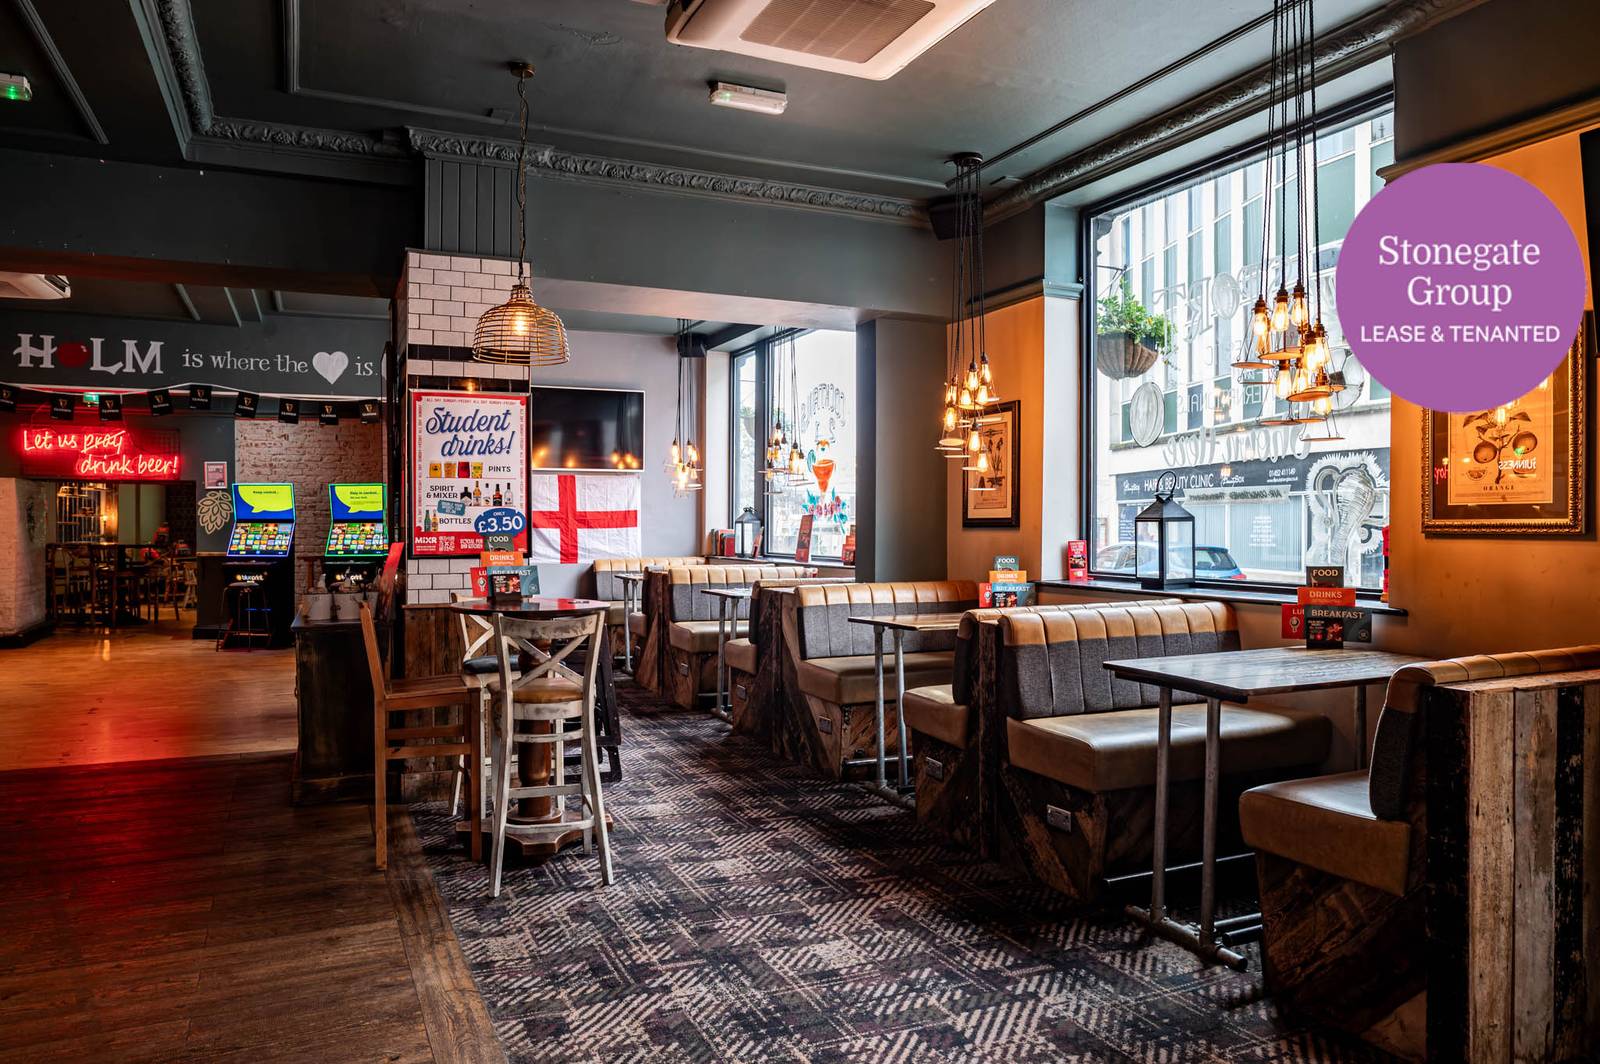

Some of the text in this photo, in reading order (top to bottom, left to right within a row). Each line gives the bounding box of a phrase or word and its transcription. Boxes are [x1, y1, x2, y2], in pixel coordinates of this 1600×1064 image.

[182, 349, 204, 368] is
[210, 351, 271, 371] where
[274, 354, 309, 373] the
[425, 407, 511, 435] Student
[23, 430, 126, 454] Let us pray
[441, 431, 515, 457] drinks!
[80, 454, 179, 474] drink beer!
[488, 465, 511, 473] PINTS
[1190, 473, 1214, 488] CLINIC
[439, 517, 472, 525] BOTTLES
[478, 515, 523, 533] £3.50
[1312, 569, 1338, 577] FOOD
[1309, 591, 1342, 599] DRINKS
[1311, 609, 1364, 619] BREAKFAST
